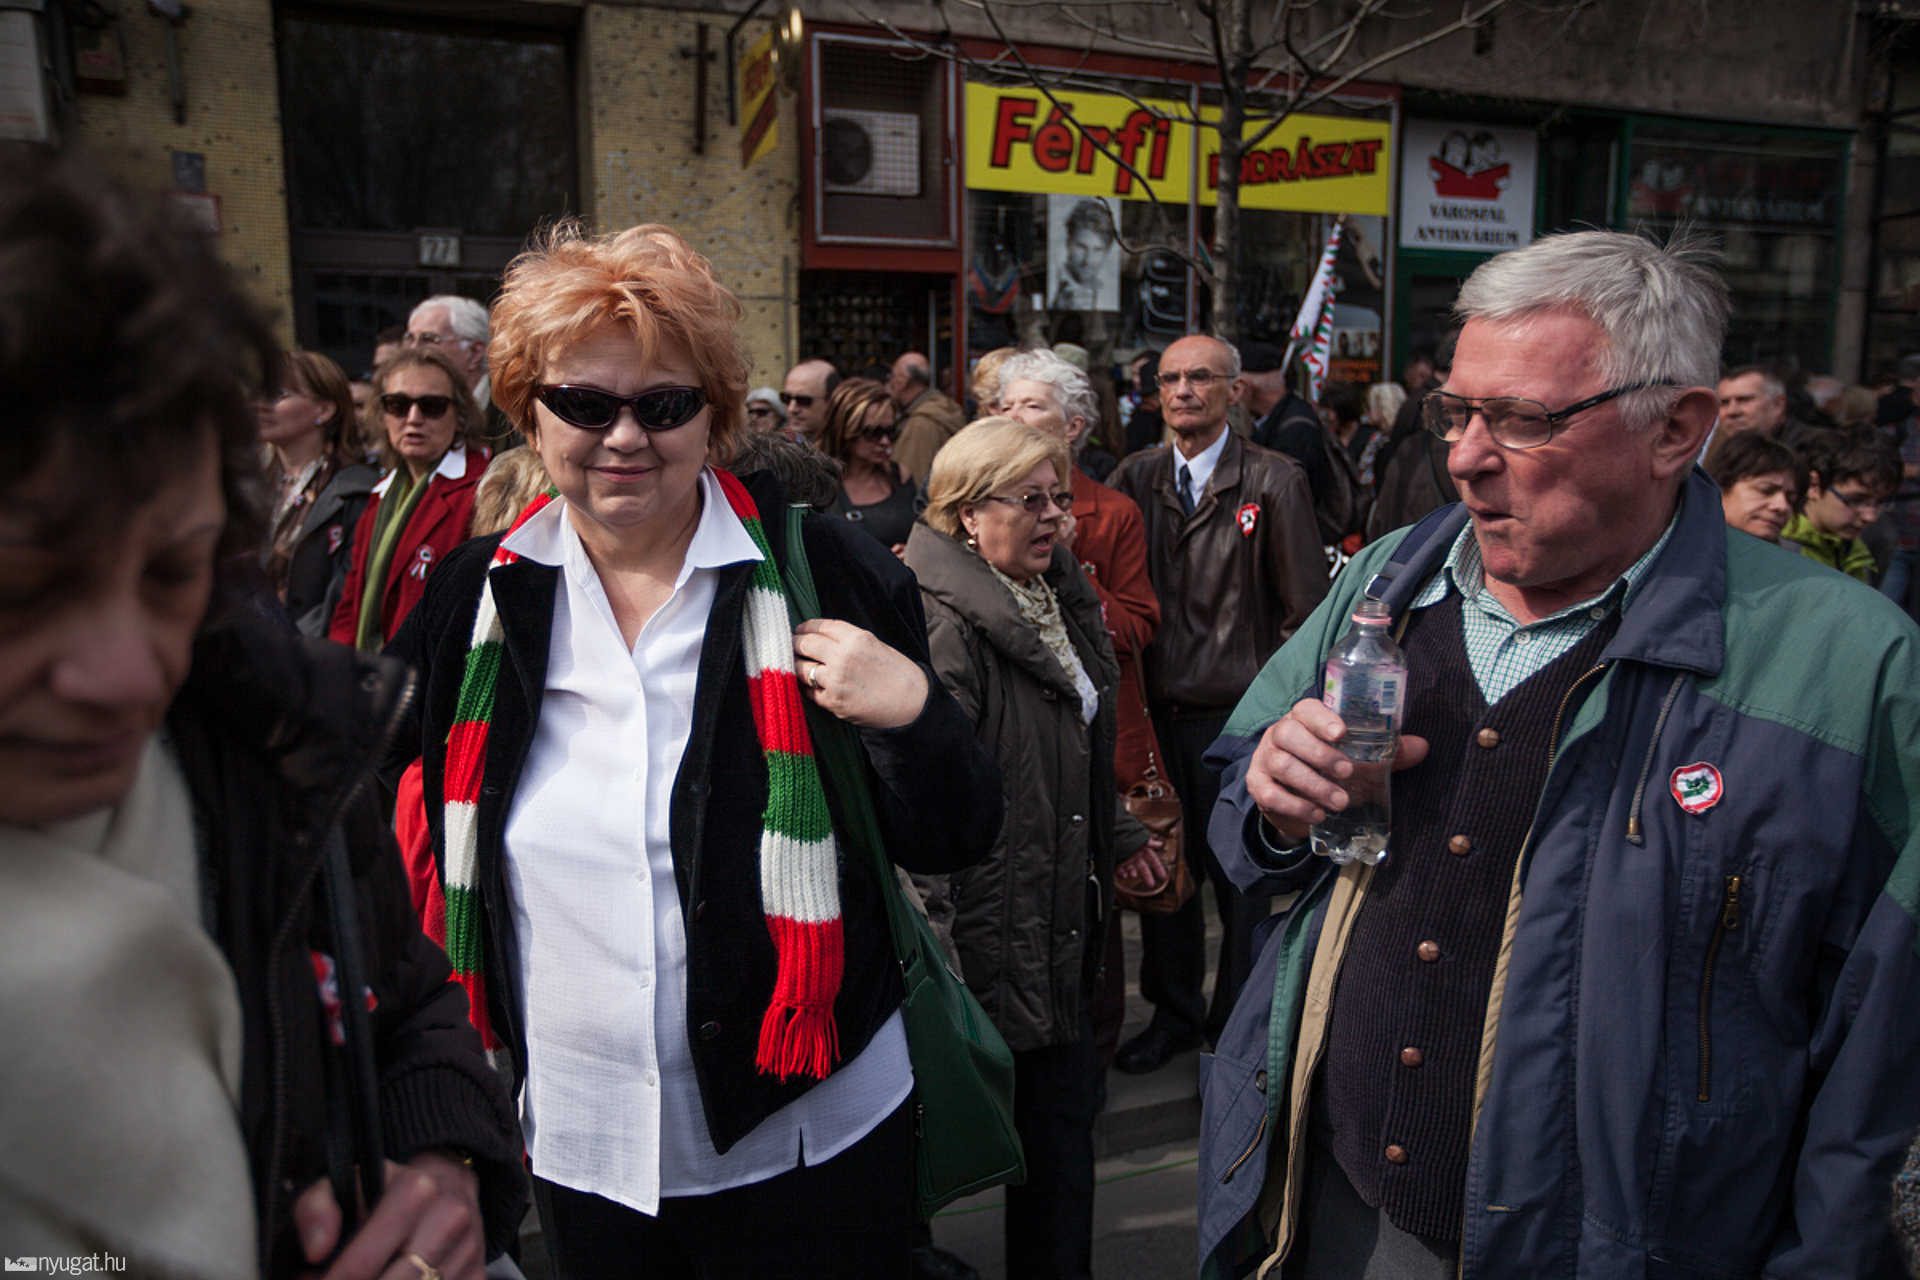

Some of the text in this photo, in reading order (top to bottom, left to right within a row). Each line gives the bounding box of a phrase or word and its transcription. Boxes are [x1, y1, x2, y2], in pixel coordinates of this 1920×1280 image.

[990, 96, 1173, 195] Férfi
[1207, 136, 1383, 189] DRÁSZAT
[1415, 225, 1519, 245] ANTIKVÁRIUM
